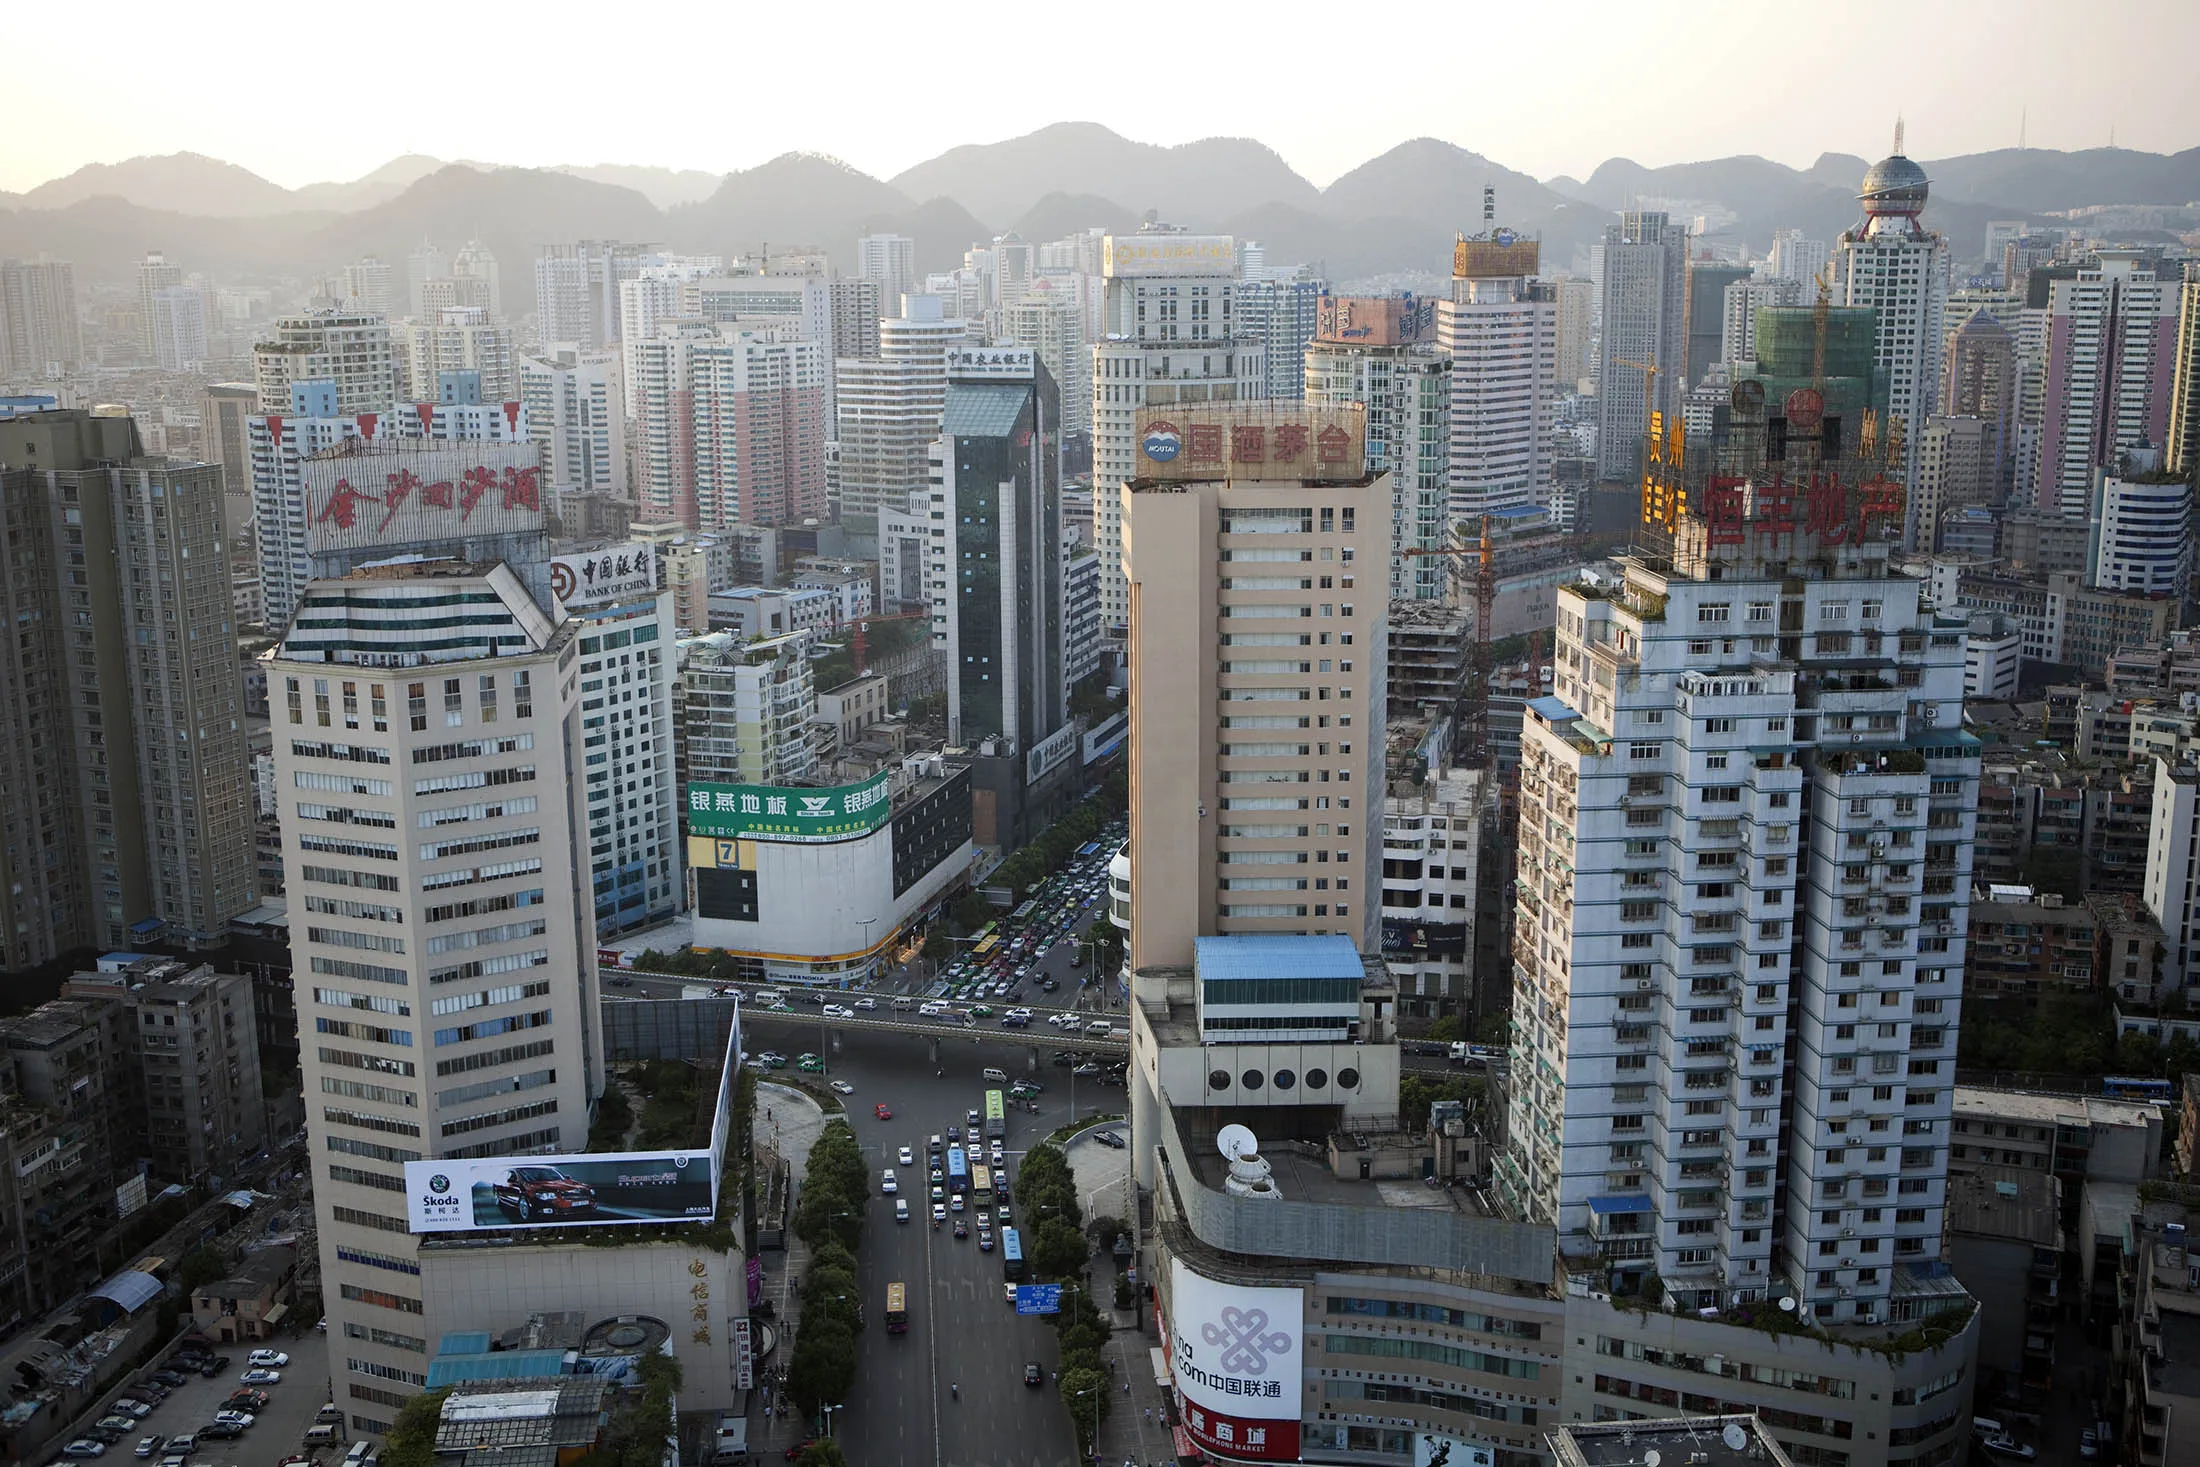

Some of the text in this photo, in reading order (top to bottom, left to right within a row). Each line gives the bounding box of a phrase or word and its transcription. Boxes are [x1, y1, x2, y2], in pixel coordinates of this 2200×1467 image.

[1148, 445, 1175, 453] MOUTAI
[1189, 423, 1351, 463] 国酒茅台
[1702, 472, 1902, 549] 恒丰地产
[584, 579, 651, 599] BANK OF CHINA
[690, 790, 788, 816] 银燕地板
[719, 843, 732, 860] 7
[423, 1195, 459, 1207] Škoda
[688, 1258, 711, 1346] 电信商城
[1209, 1374, 1281, 1398] 中国联通
[1235, 1443, 1266, 1453] MARKET
